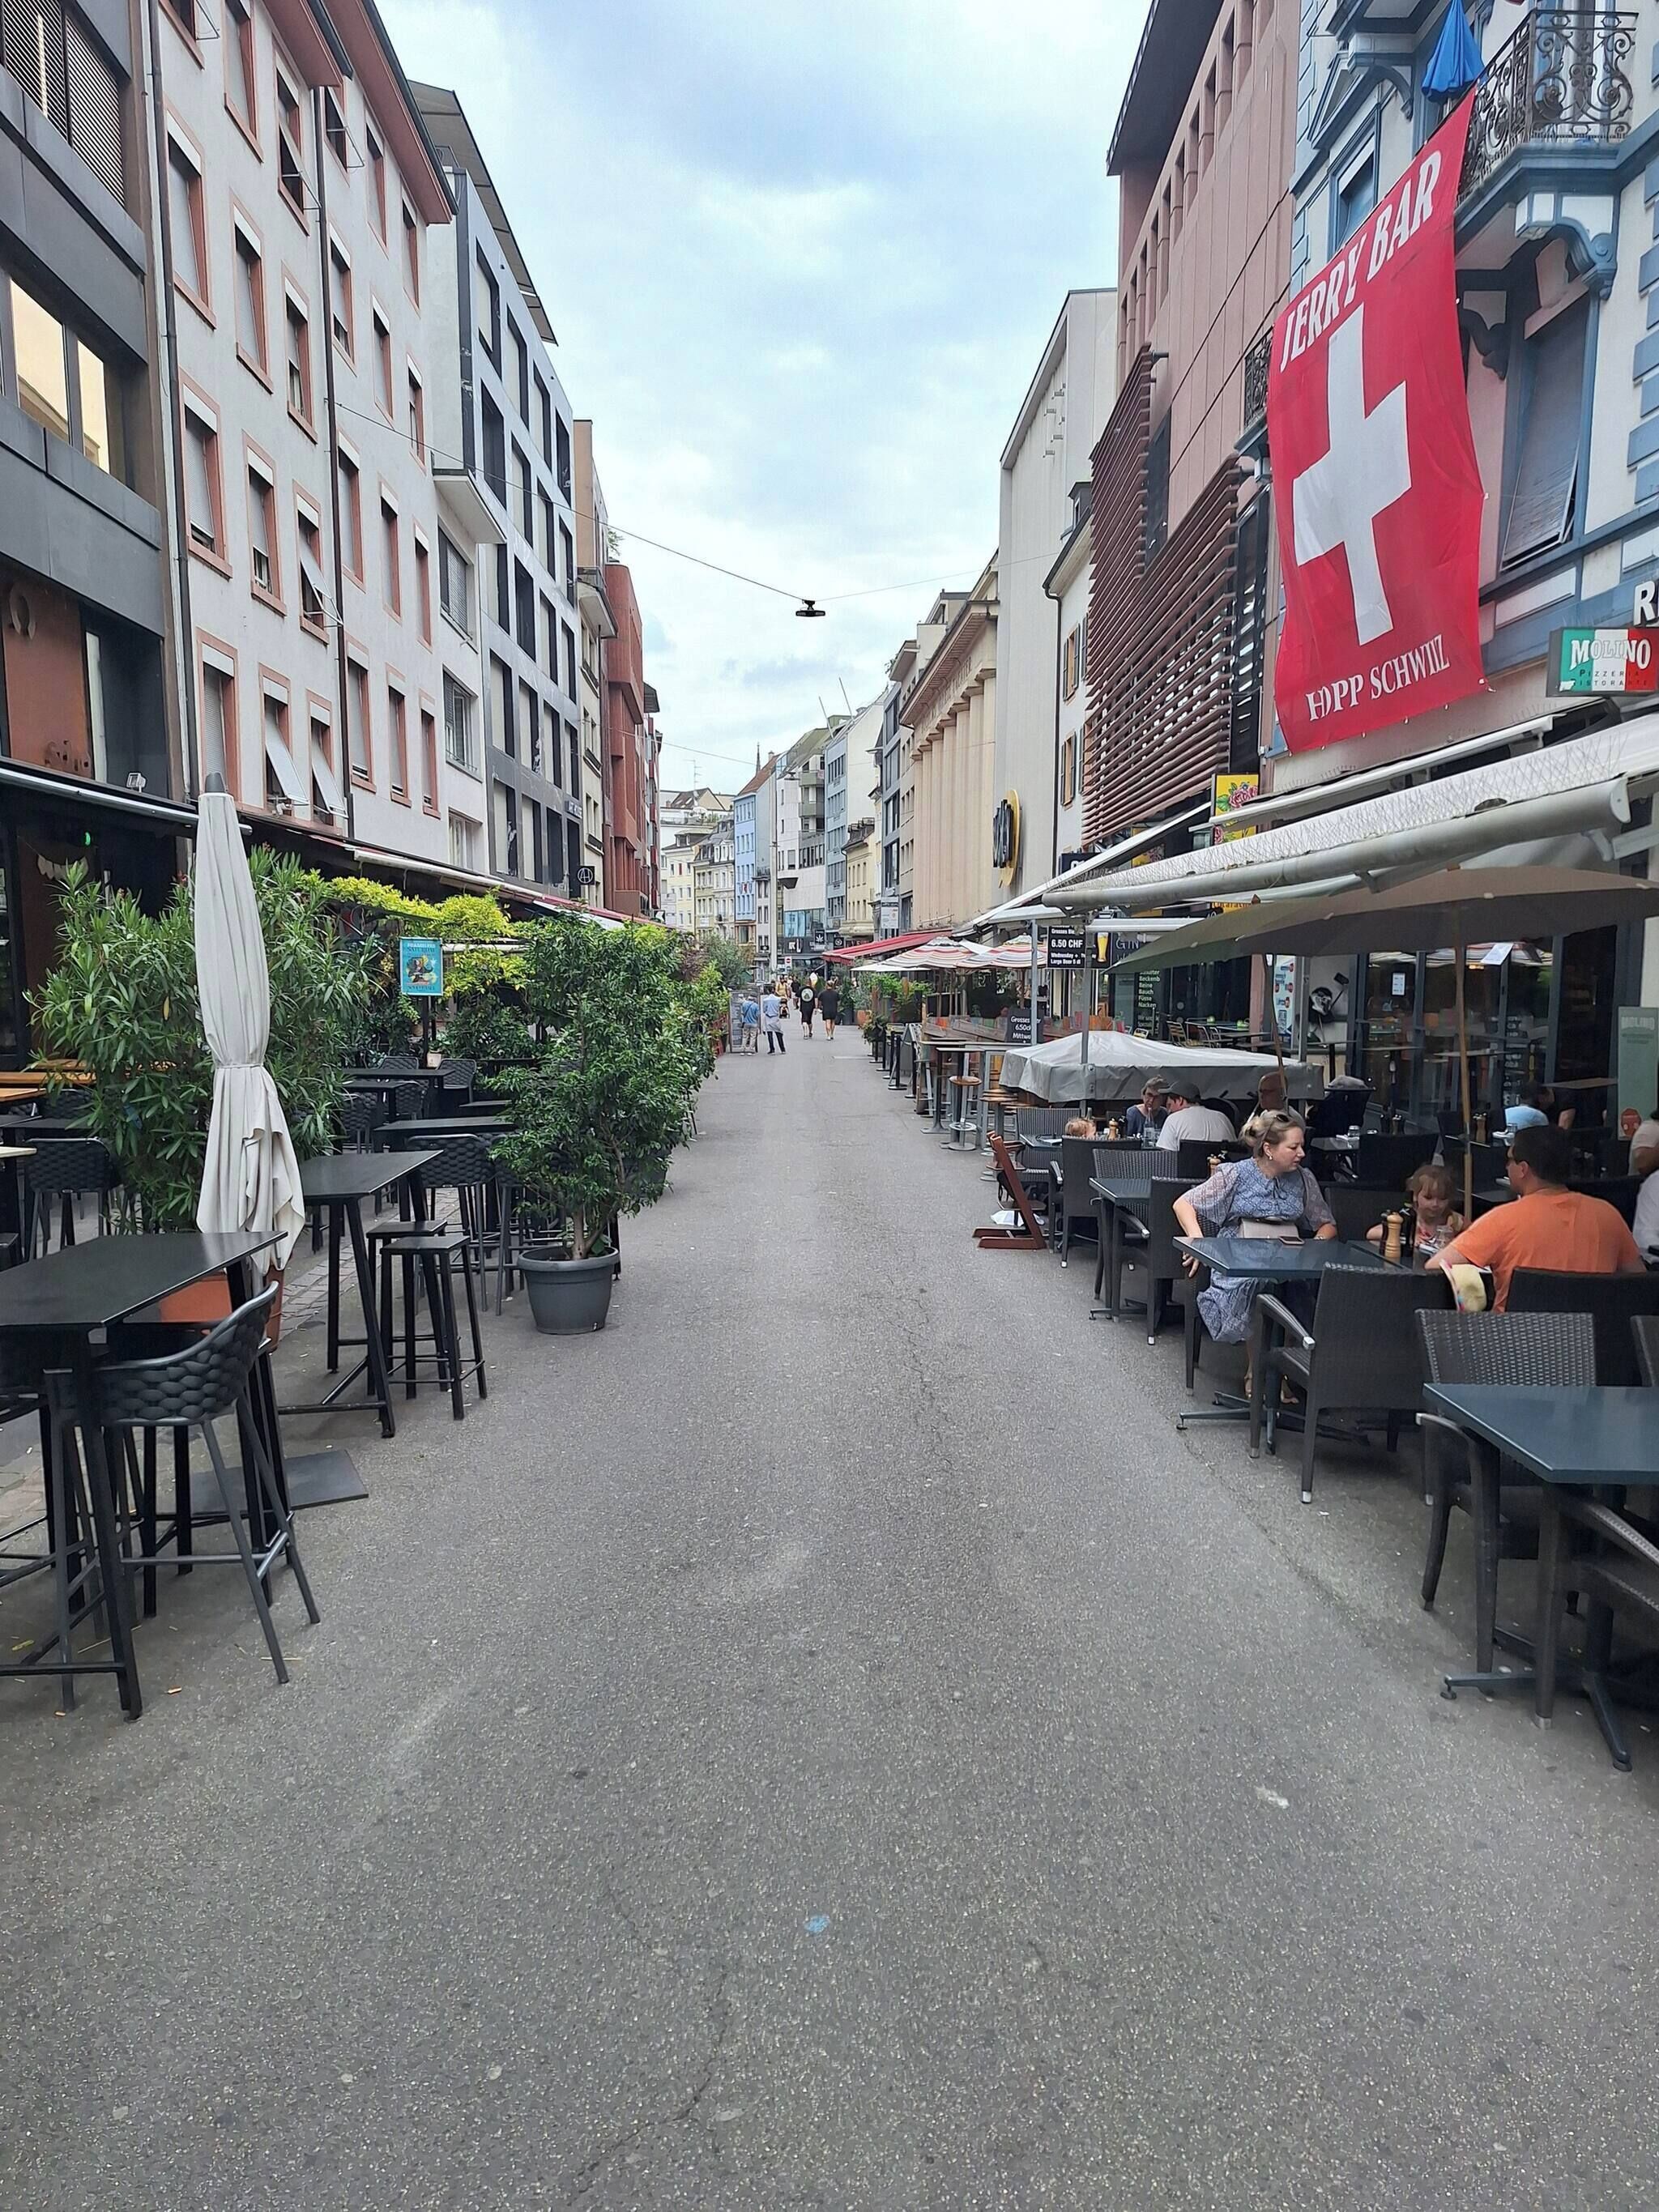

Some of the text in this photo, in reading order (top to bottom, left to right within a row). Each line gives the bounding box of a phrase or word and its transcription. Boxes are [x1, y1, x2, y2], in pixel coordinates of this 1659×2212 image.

[1280, 151, 1442, 373] JERRY BAR
[1633, 580, 1659, 626] R
[1370, 634, 1450, 700] SCHWIZ
[1569, 638, 1652, 671] MOLINO
[1580, 669, 1640, 677] PIZZERIA
[1051, 939, 1083, 948] 6.50 CHF
